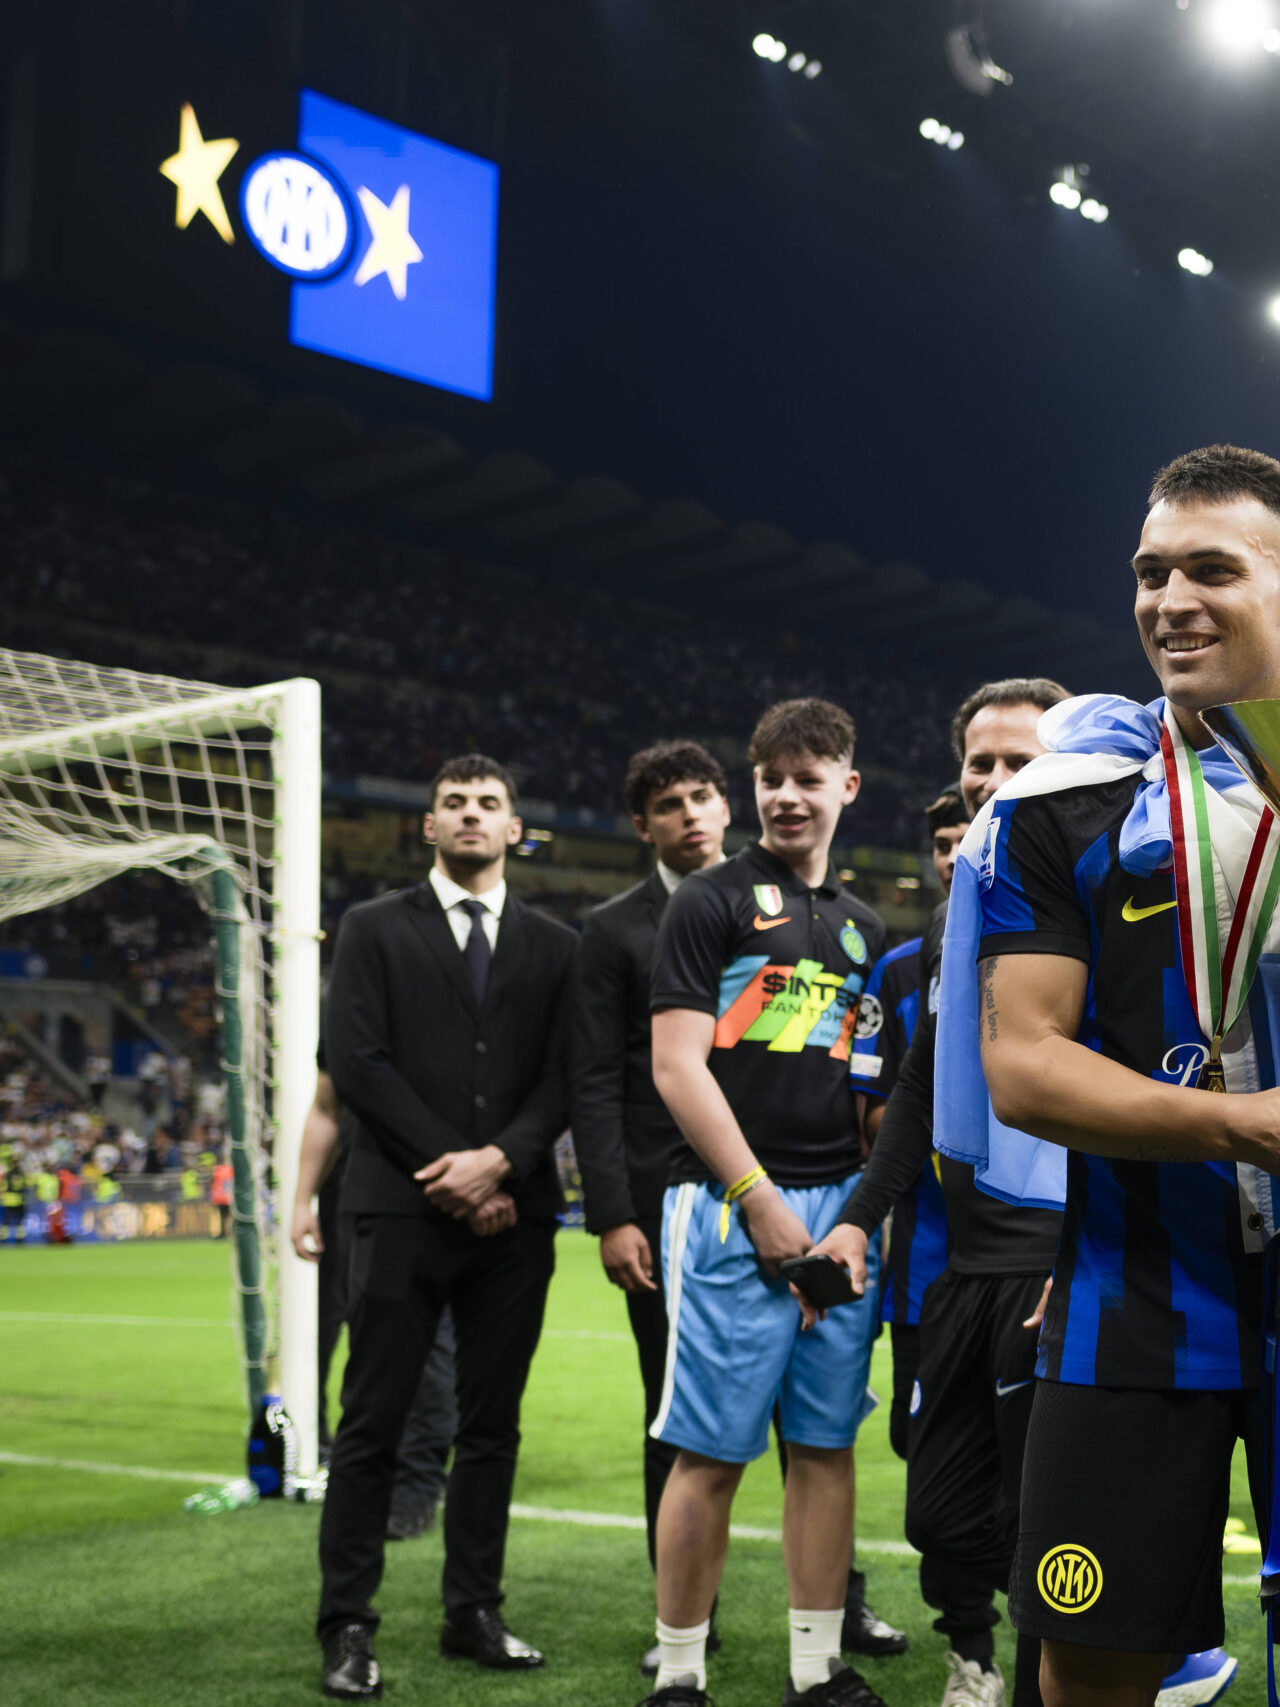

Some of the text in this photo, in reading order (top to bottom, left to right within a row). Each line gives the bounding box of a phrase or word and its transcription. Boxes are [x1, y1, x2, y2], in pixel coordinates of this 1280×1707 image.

[762, 1001, 801, 1015] FAN
[984, 983, 996, 1010] you
[987, 1010, 999, 1042] love
